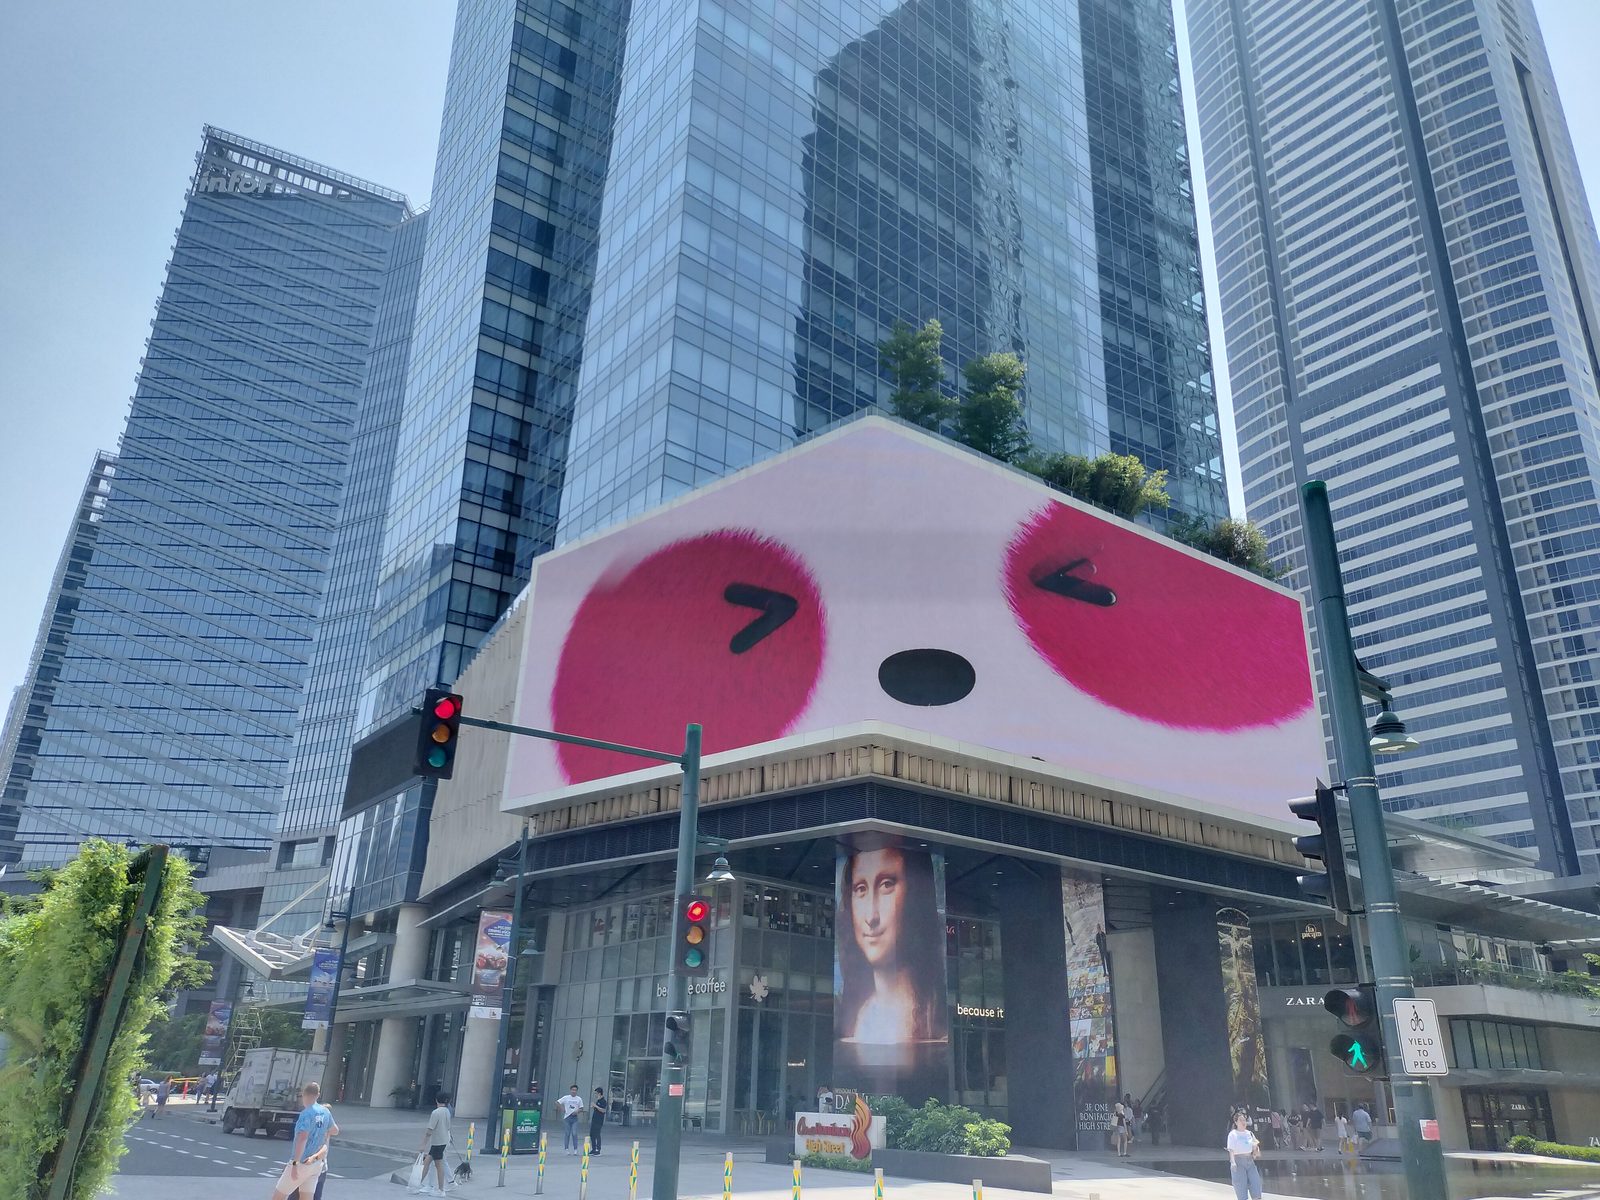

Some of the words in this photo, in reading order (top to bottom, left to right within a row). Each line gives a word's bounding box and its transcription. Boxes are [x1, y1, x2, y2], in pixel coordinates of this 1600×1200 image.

[199, 170, 273, 193] infor
[695, 978, 726, 994] coffee
[1286, 997, 1325, 1006] ZARA
[957, 1003, 995, 1017] because
[997, 1007, 1004, 1018] it
[1408, 1038, 1434, 1046] YIELD
[1417, 1049, 1429, 1057] TO
[1413, 1061, 1437, 1069] PEDS
[1095, 1103, 1109, 1112] ONE
[1079, 1122, 1095, 1130] HIGH
[1097, 1122, 1111, 1130] STRE
